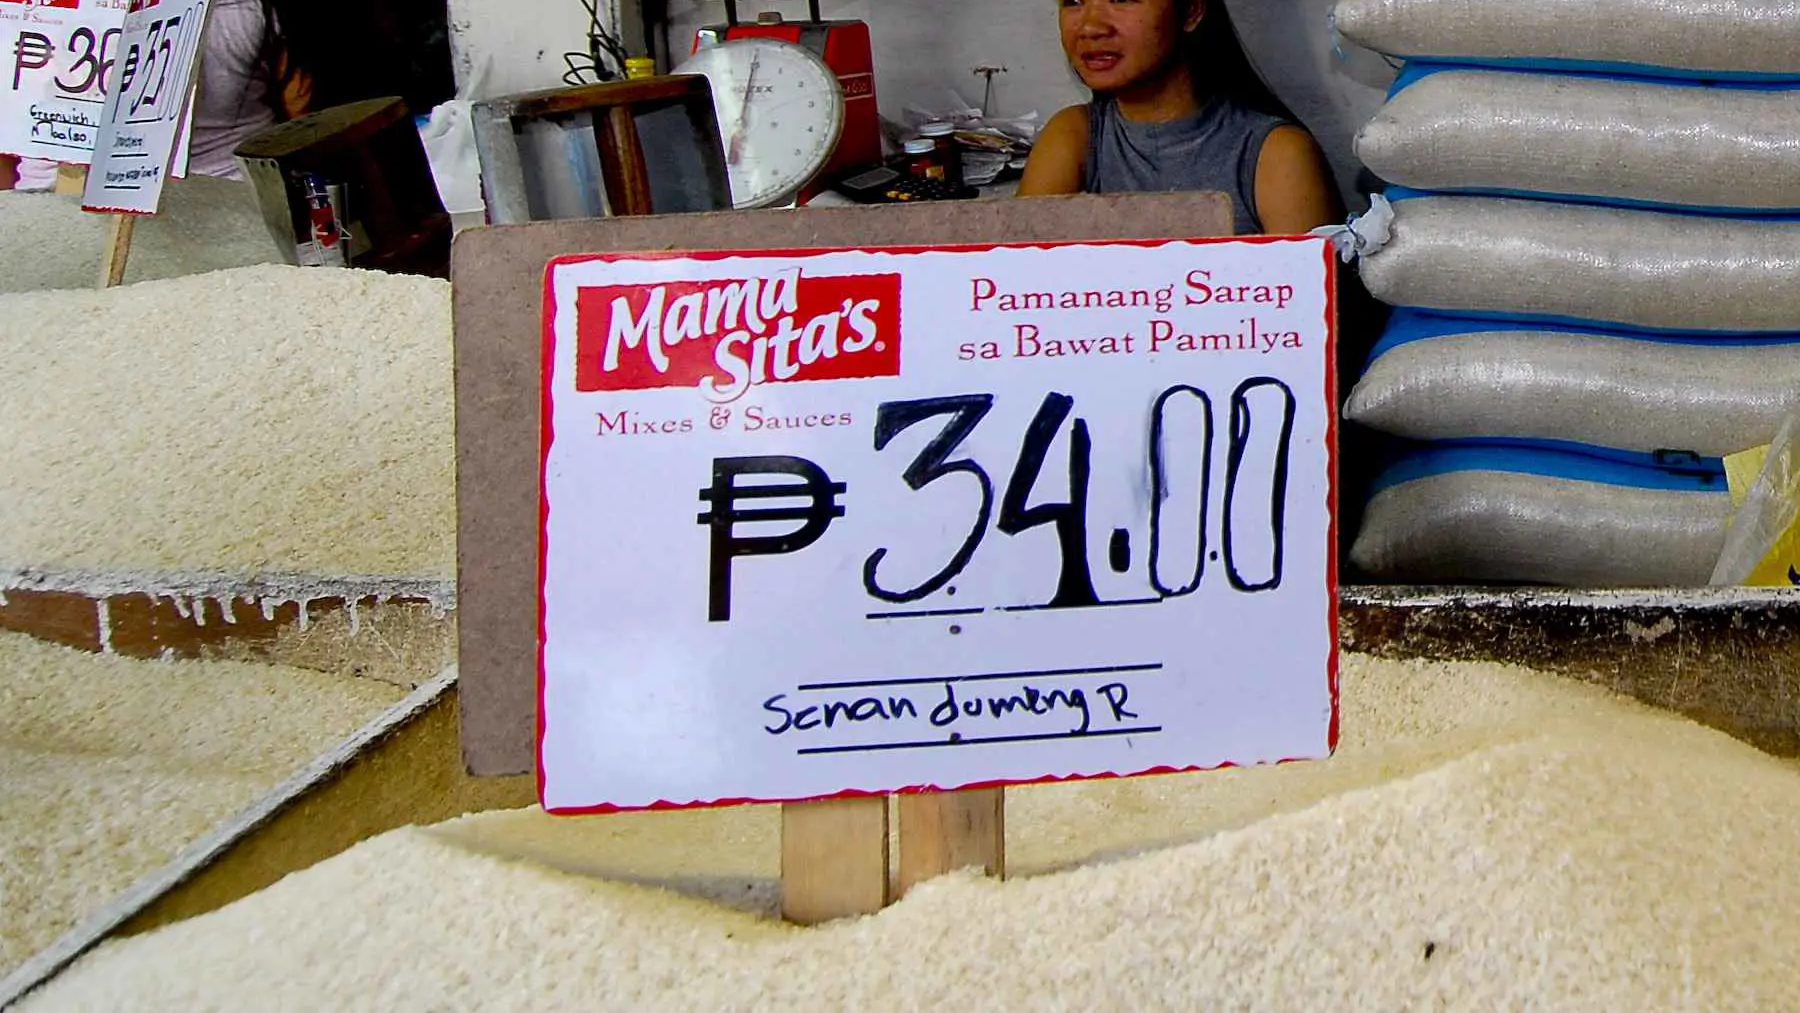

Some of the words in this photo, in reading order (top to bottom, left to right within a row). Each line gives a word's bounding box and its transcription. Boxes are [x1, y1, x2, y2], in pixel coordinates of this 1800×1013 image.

[969, 277, 1175, 313] Pamanang
[1184, 270, 1294, 309] Sarap
[603, 268, 802, 373] Mama
[958, 340, 1001, 361] sa
[1012, 324, 1136, 358] Bawat
[1147, 317, 1304, 354] Pamilya
[699, 298, 880, 404] Sita's
[597, 410, 694, 436] Mixes
[709, 406, 731, 430] &
[743, 405, 853, 431] Sauces
